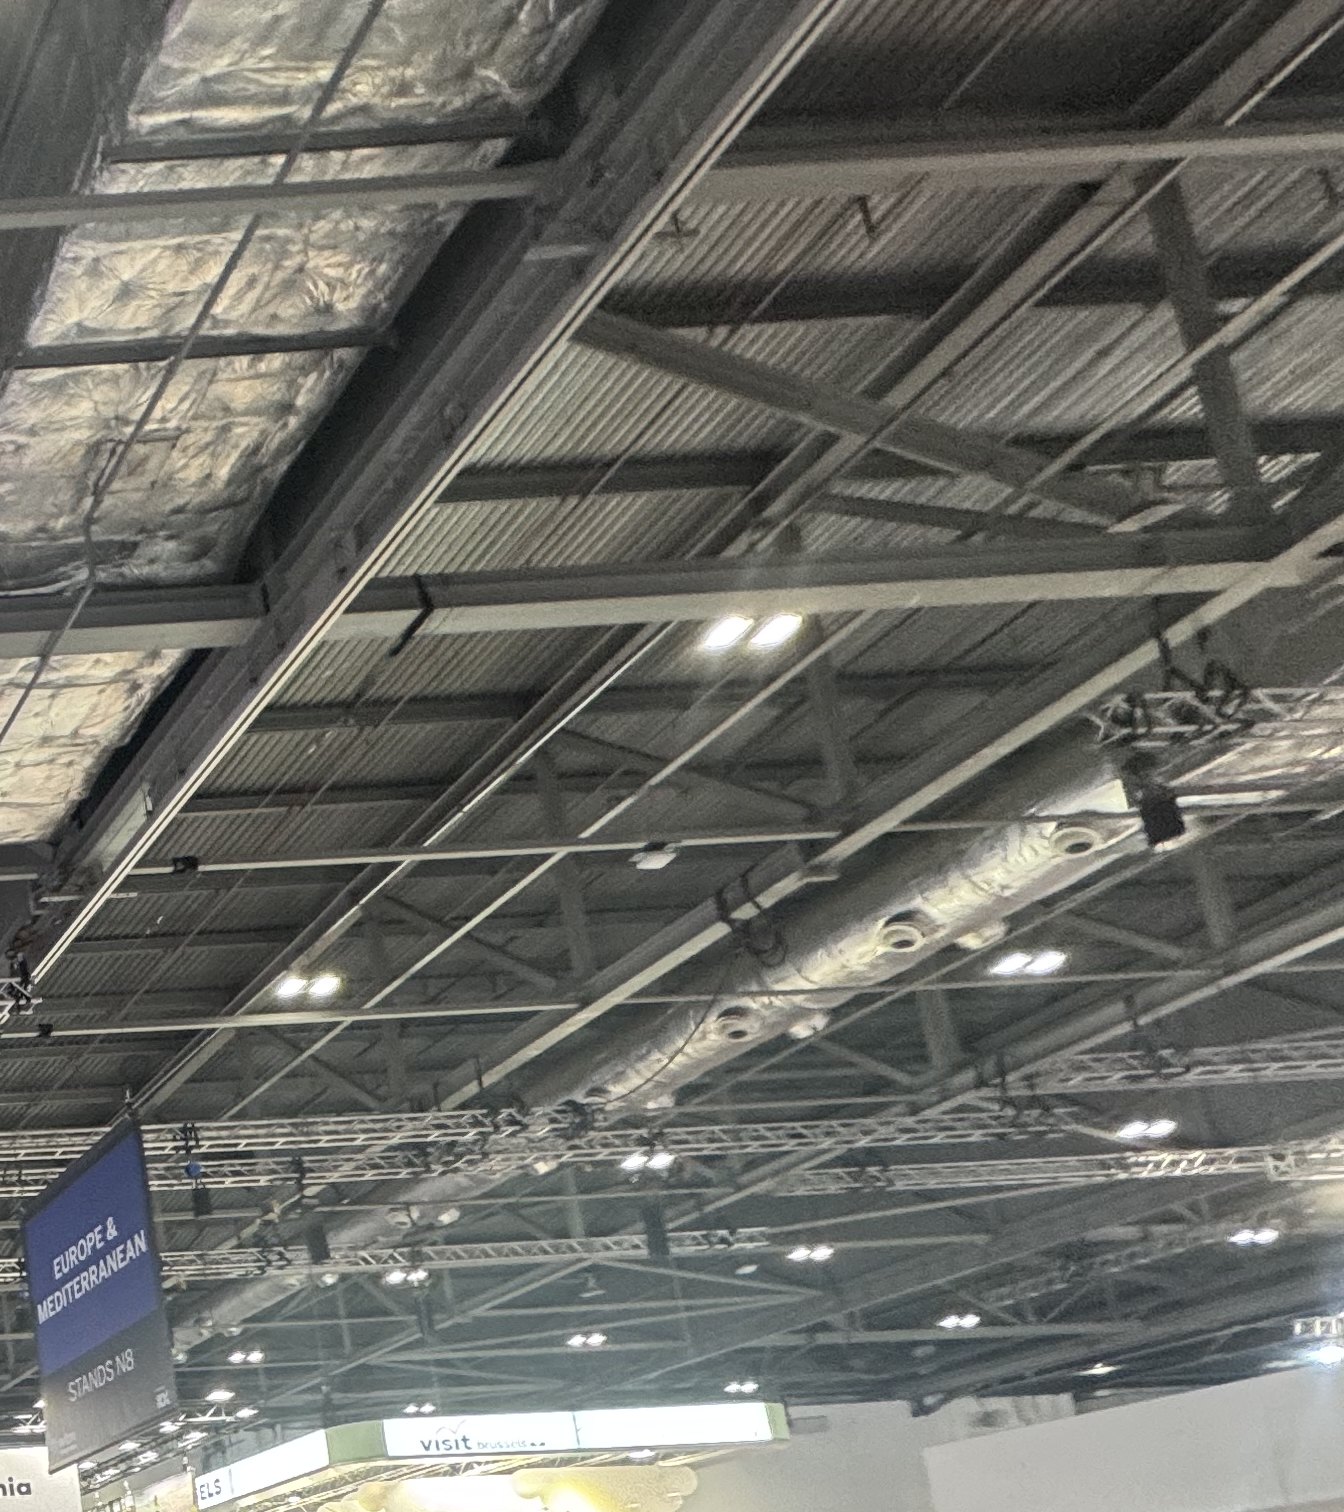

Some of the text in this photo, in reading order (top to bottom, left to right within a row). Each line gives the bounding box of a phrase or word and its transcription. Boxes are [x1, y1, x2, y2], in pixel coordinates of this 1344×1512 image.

[53, 1216, 118, 1281] EUROPE &
[36, 1229, 147, 1325] MEDITERRANEAN
[67, 1357, 115, 1403] STANDS
[419, 1434, 473, 1451] visit
[199, 1478, 223, 1500] ELS
